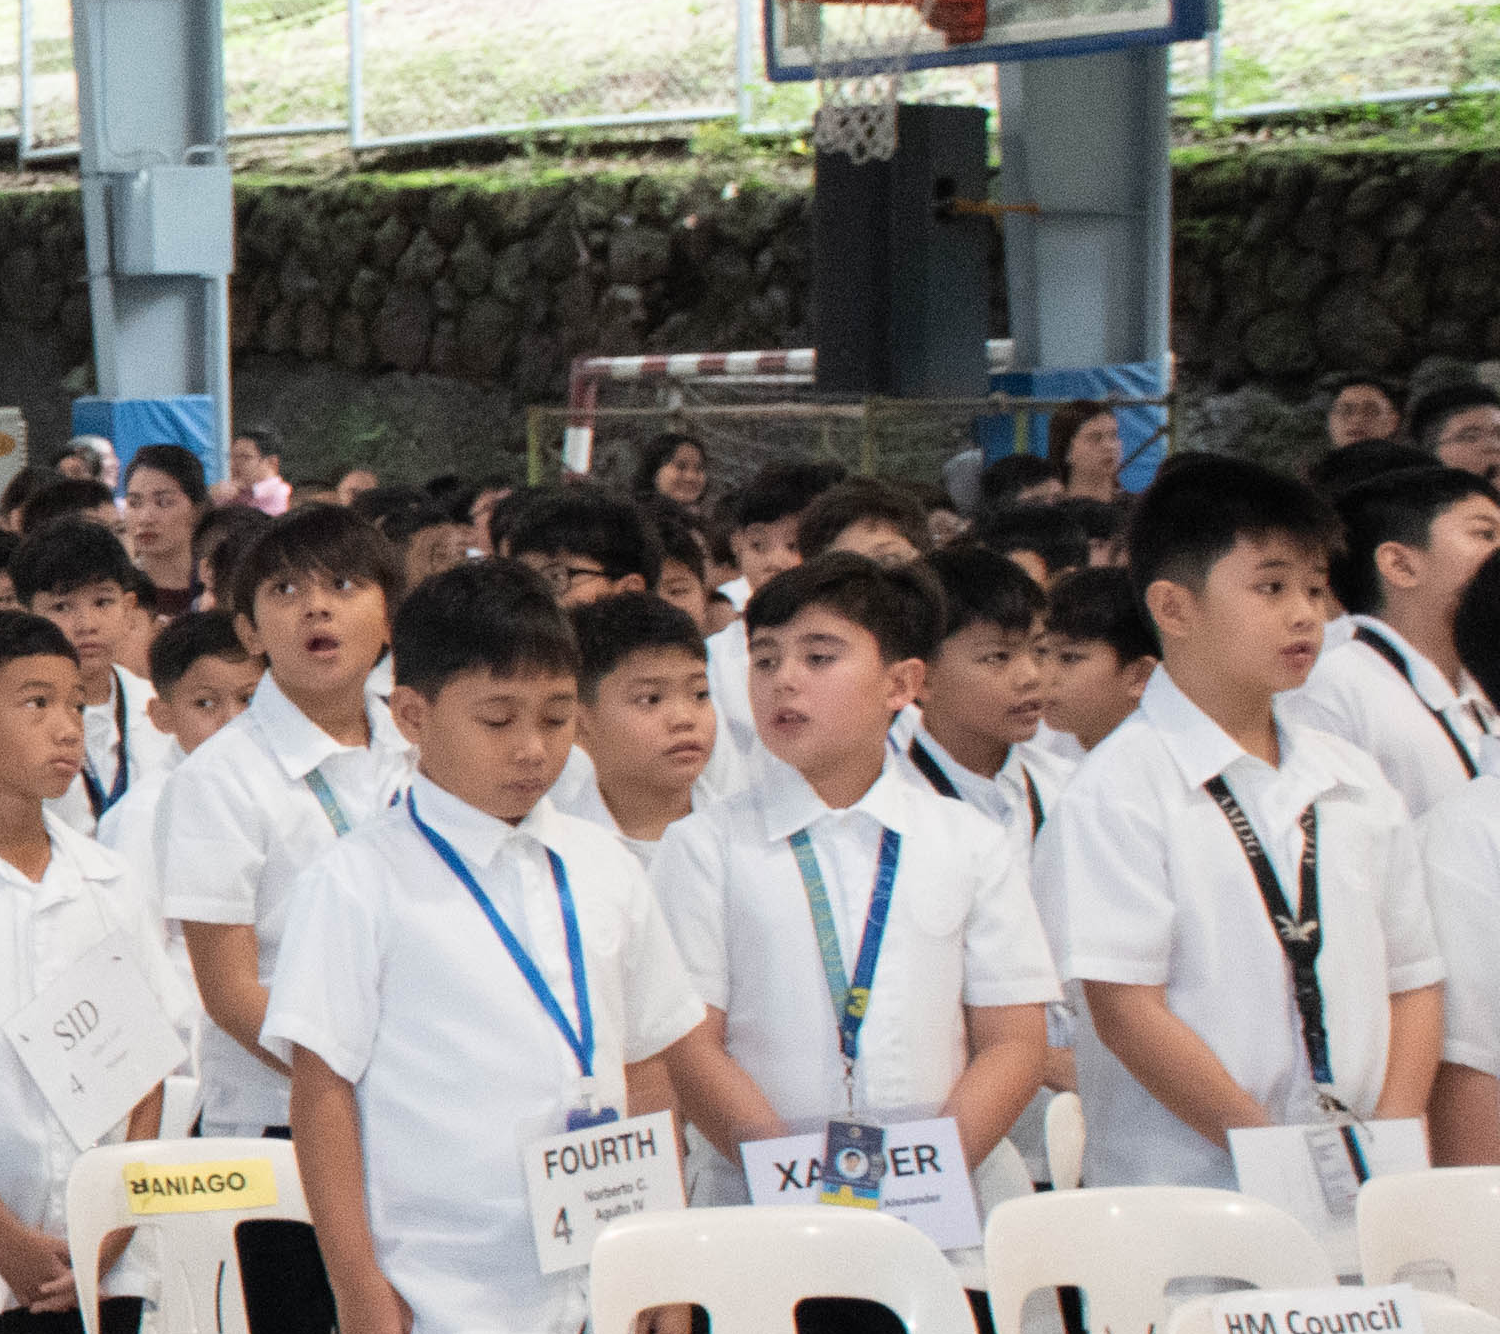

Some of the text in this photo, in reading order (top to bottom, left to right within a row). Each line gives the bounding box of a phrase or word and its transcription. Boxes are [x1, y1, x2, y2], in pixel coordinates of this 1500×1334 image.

[52, 999, 99, 1051] SID
[543, 1127, 657, 1180] FOURTH
[773, 1143, 942, 1192] XAER
[553, 1205, 573, 1245] 4
